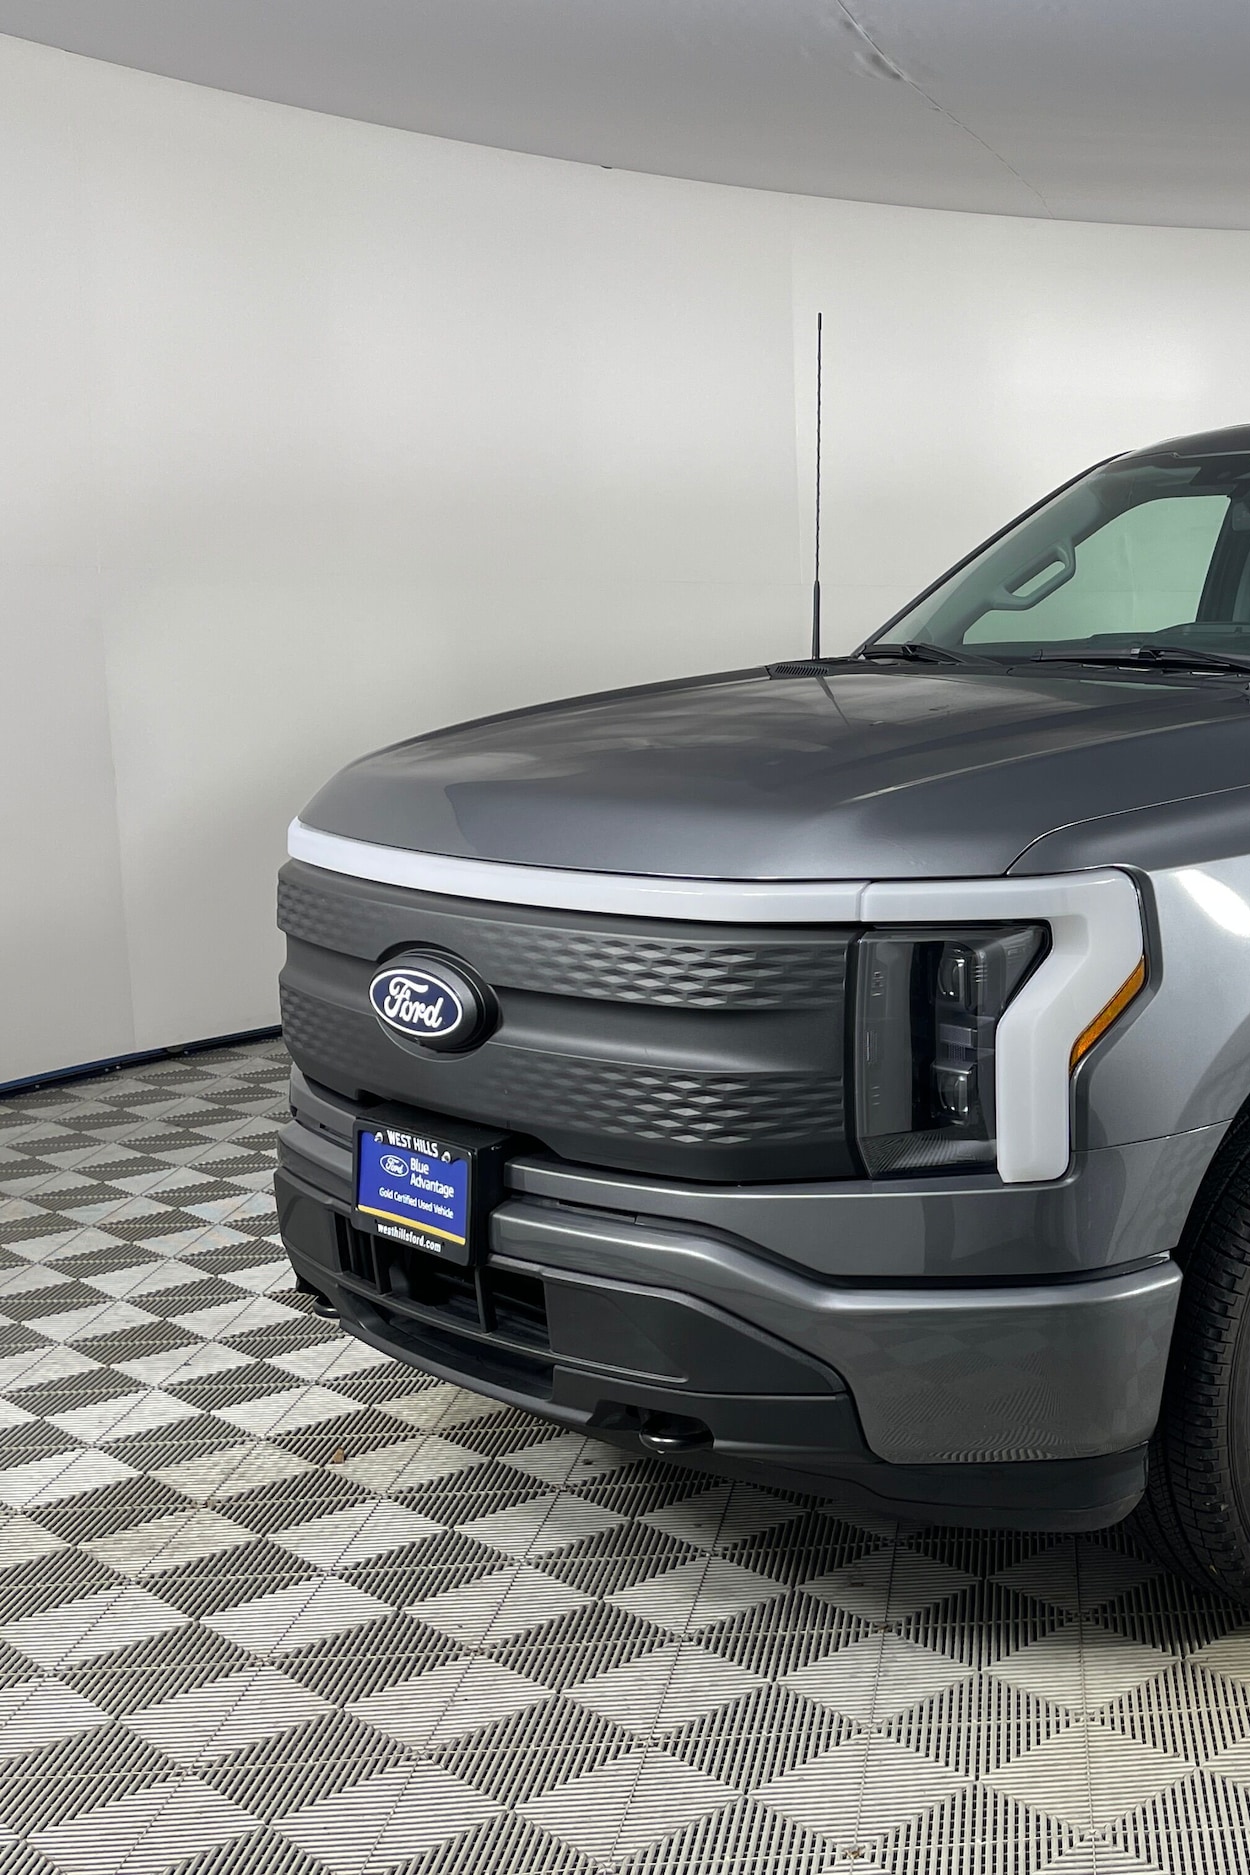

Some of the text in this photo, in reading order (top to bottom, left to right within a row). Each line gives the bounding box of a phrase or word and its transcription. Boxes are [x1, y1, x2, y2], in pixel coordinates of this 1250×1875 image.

[384, 977, 444, 1028] Ford
[386, 1129, 439, 1158] WEST HILLS
[385, 1157, 430, 1175] Ford Blue
[410, 1173, 455, 1198] Advantage
[379, 1187, 454, 1219] Gold Certified Used Vehicle
[377, 1223, 441, 1252] westhillsford.com
